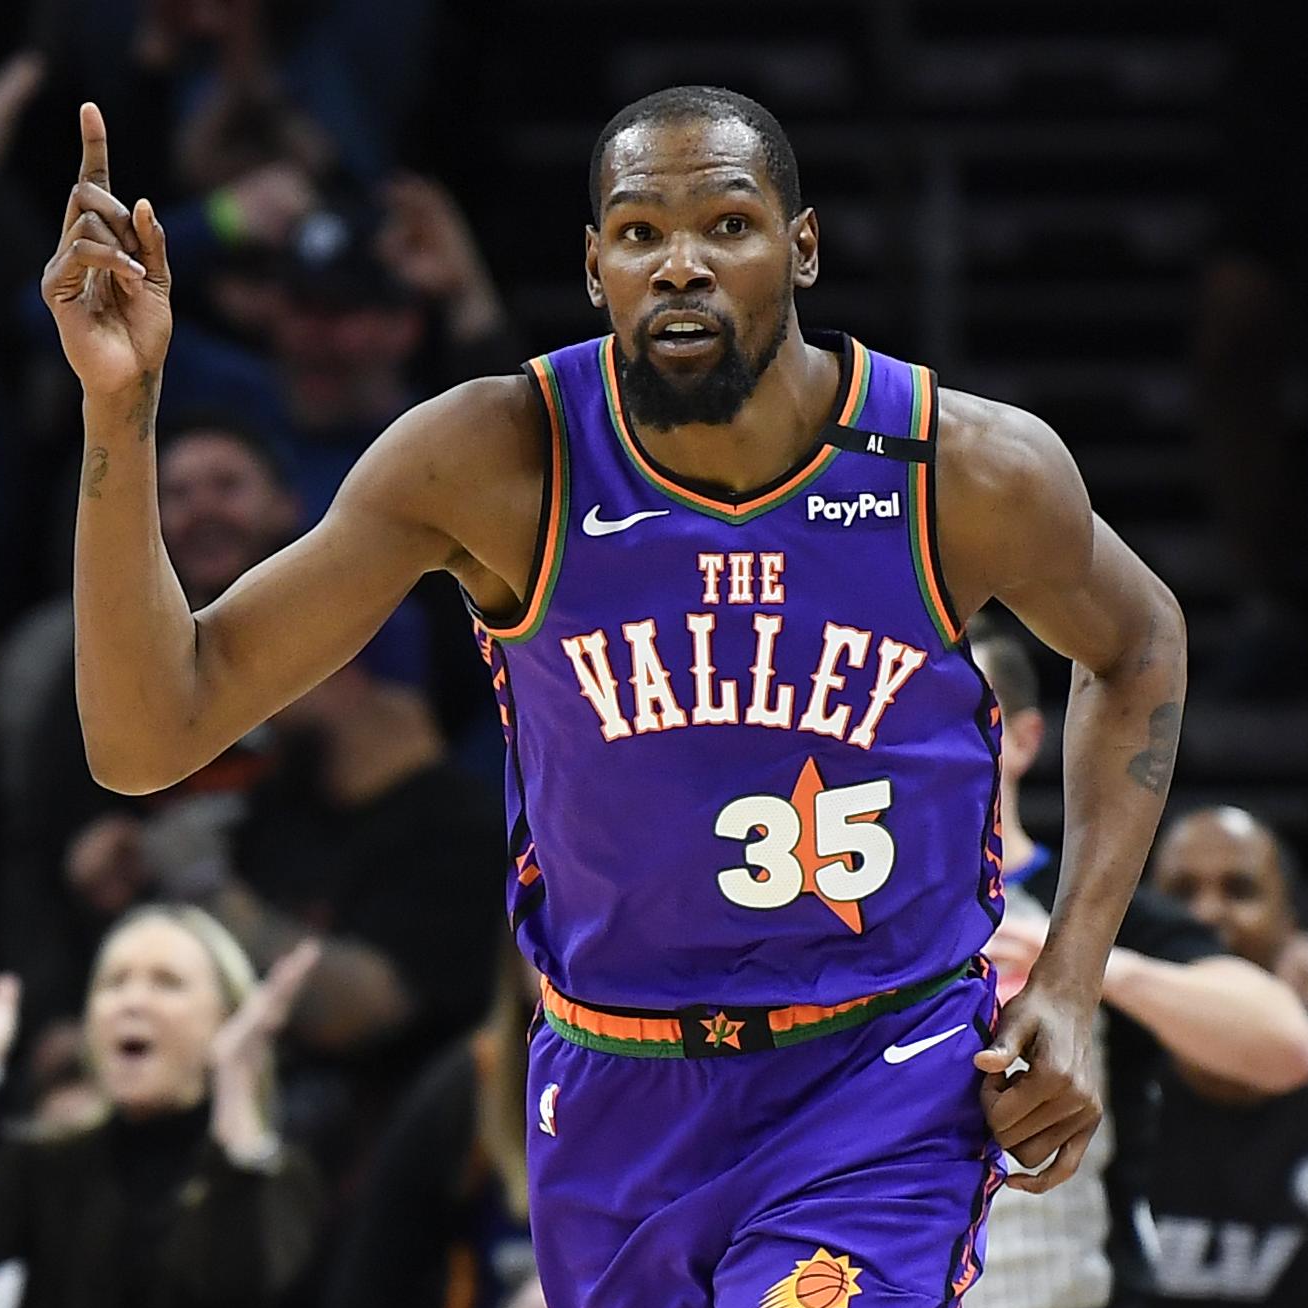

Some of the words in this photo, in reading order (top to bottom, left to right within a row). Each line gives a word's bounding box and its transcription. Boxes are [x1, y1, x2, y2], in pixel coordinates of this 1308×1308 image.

[866, 434, 885, 454] AL
[807, 492, 900, 526] PayPal
[697, 551, 785, 604] THE
[560, 612, 927, 750] VALLEY
[714, 779, 896, 911] 35
